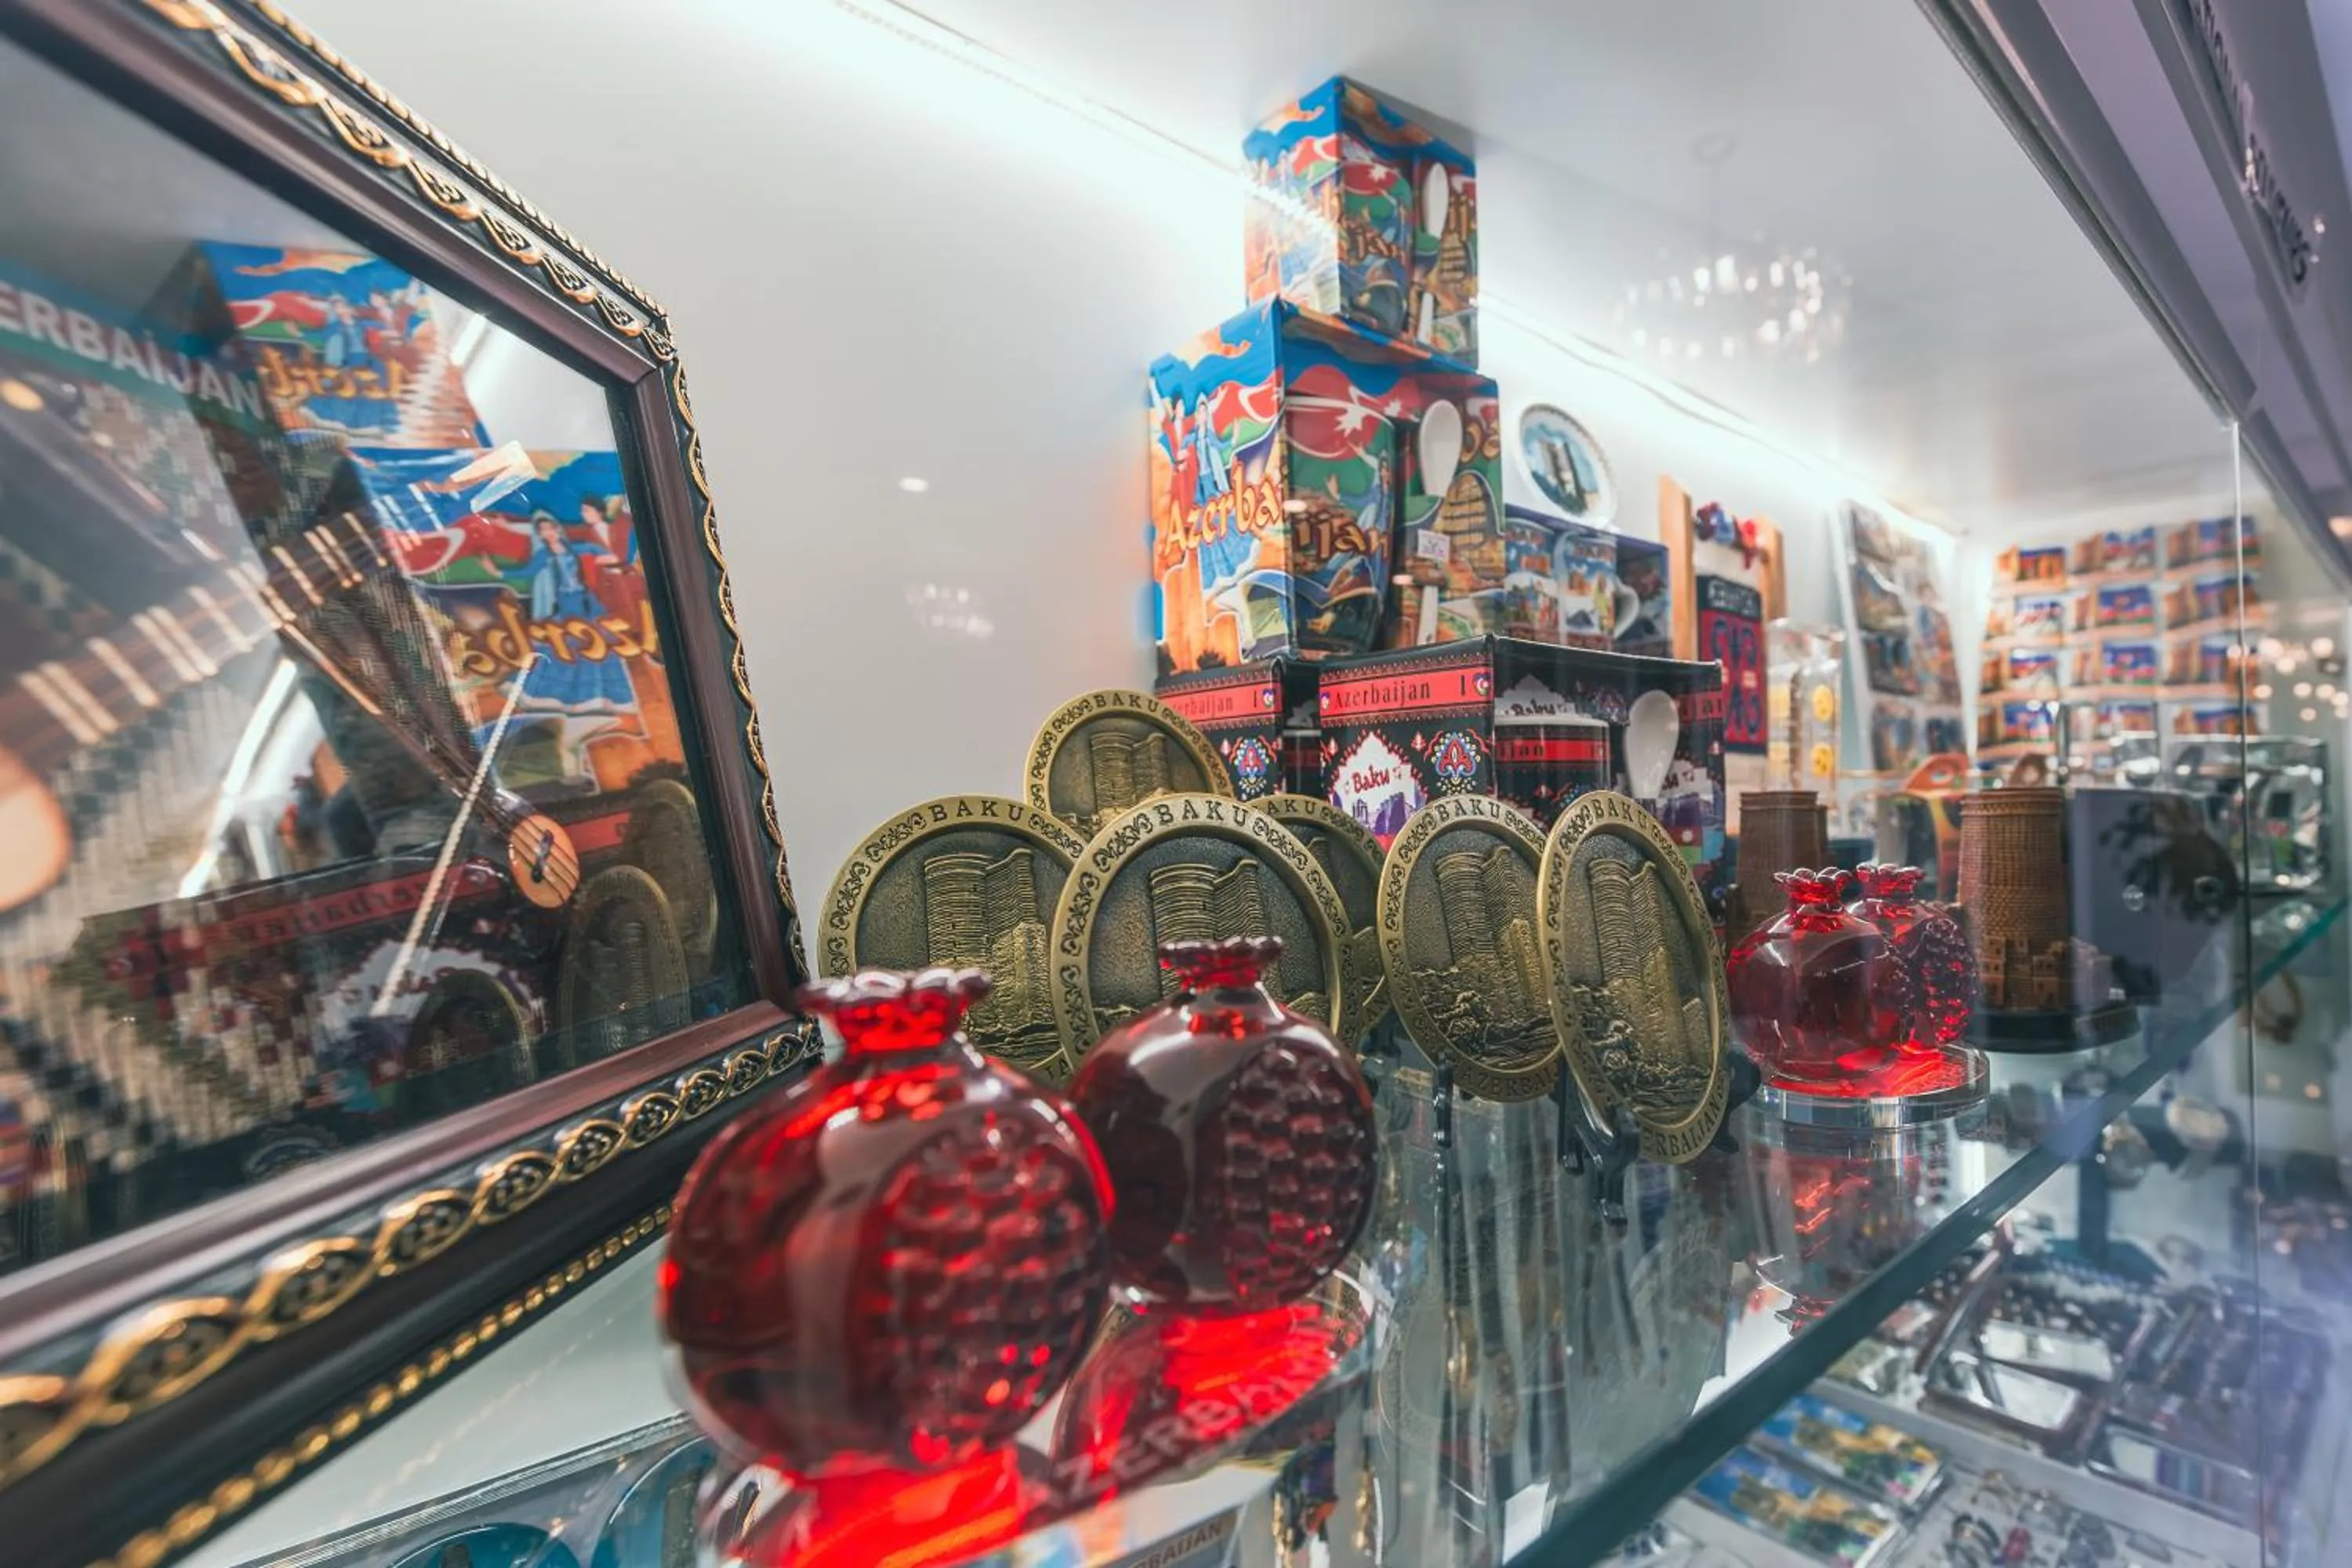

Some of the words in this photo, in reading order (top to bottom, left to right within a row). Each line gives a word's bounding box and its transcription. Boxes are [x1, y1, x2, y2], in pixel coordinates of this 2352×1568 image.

[1093, 692, 1160, 713] BAKU
[1334, 681, 1430, 709] Azerbaijan
[1352, 764, 1388, 794] Baku
[927, 799, 1025, 822] BAKU
[1153, 799, 1249, 827] BAKU
[1254, 798, 1317, 815] AKU
[1434, 797, 1501, 822] BAKU
[1592, 797, 1650, 831] BAKU
